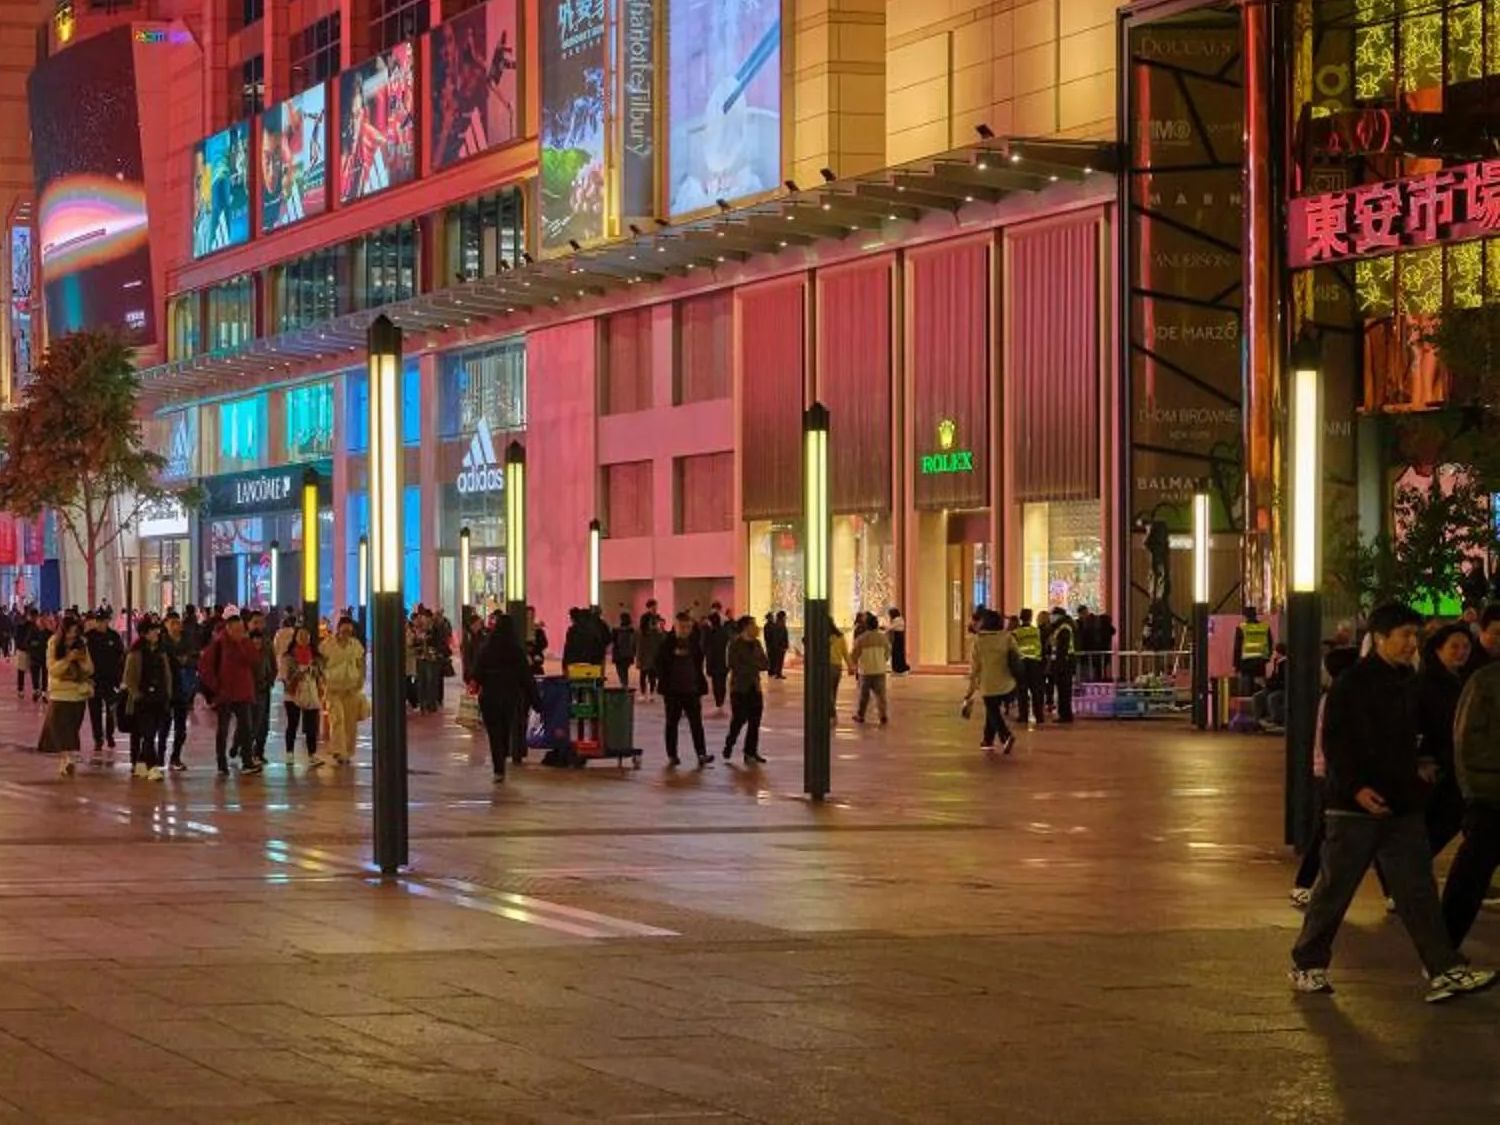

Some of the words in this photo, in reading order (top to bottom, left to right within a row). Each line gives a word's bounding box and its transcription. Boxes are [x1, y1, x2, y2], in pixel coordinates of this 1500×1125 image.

[922, 452, 973, 474] ROLEX
[236, 475, 281, 504] LANCÔME
[457, 465, 504, 493] adidas
